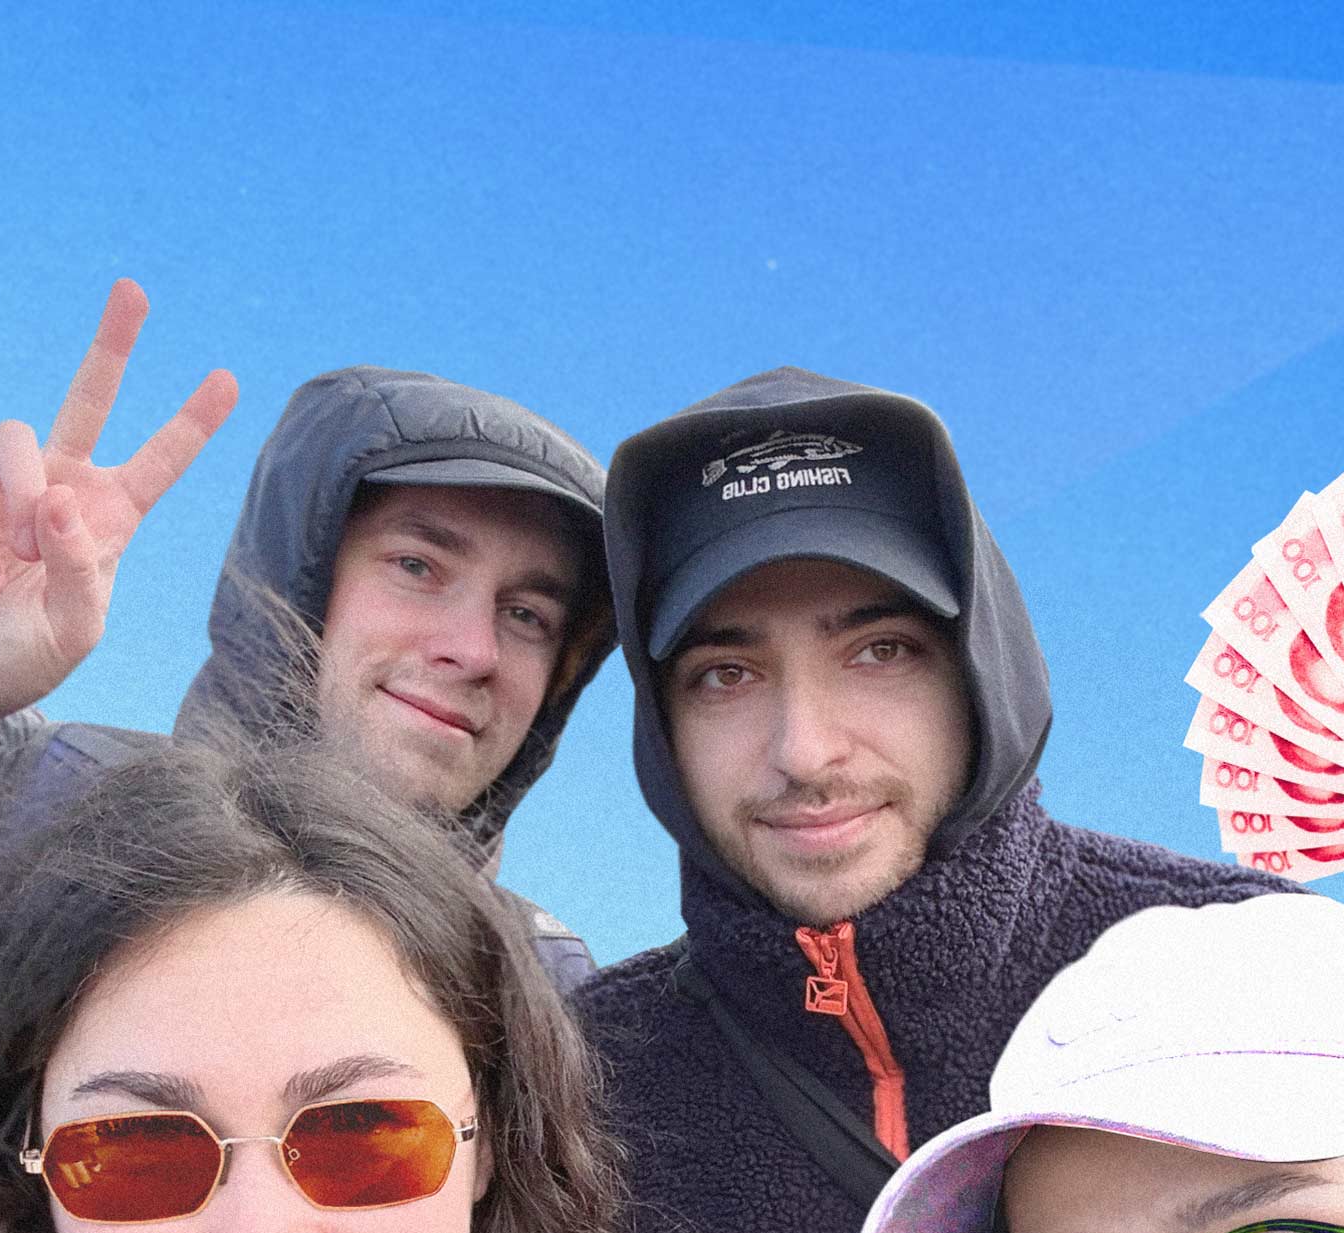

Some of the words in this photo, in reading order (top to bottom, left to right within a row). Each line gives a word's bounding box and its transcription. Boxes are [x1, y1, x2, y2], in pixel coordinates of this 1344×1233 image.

[1282, 538, 1322, 591] 100
[1233, 596, 1280, 642] 100
[1213, 652, 1262, 693] 100
[1209, 709, 1259, 745] 100
[1215, 763, 1260, 792] 100
[1231, 811, 1274, 834] 100
